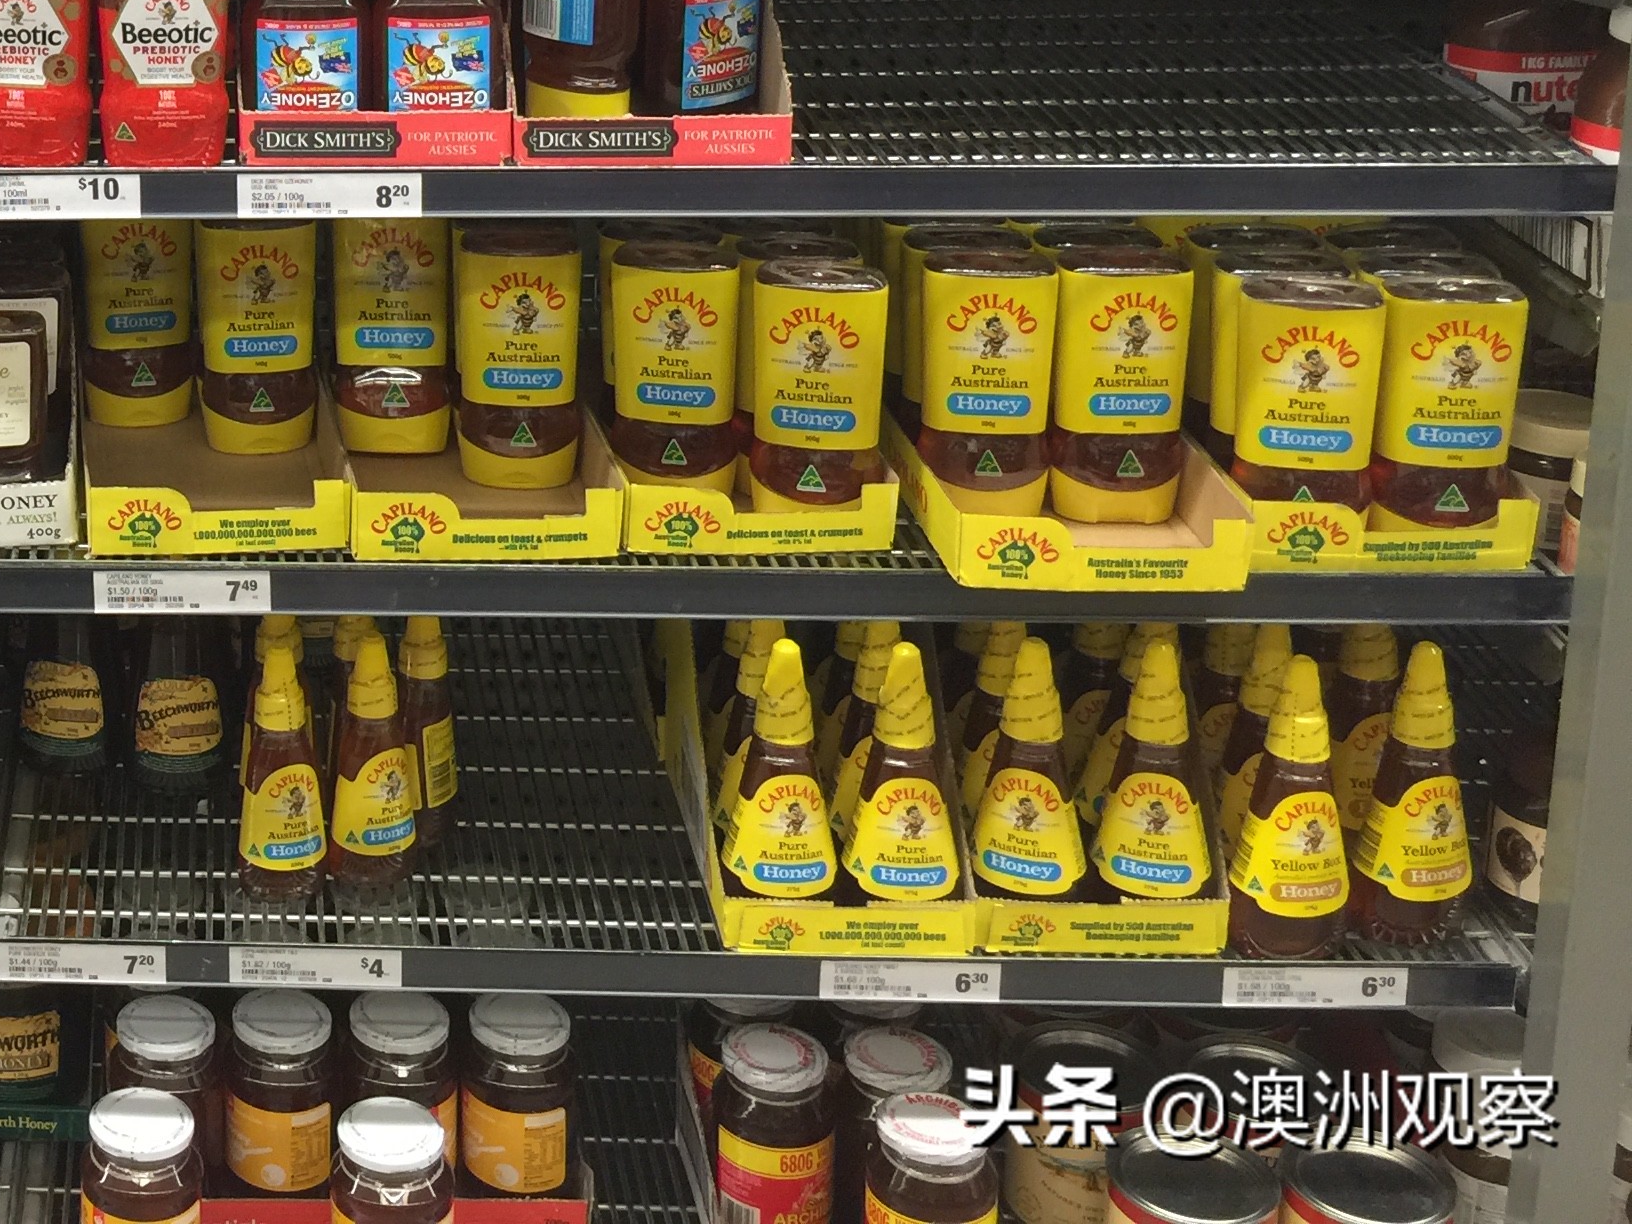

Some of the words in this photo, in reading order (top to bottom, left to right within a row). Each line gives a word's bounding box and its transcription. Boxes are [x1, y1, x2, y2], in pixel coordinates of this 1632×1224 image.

[122, 21, 213, 46] Beeotic
[133, 44, 200, 56] PREBIOTIC
[148, 55, 187, 65] HONEY
[390, 90, 489, 108] OZEHONEY
[265, 130, 307, 149] DICK
[314, 129, 385, 149] SMITH'S
[407, 132, 426, 144] FOR
[429, 131, 498, 144] PATRIOTIC
[540, 130, 582, 148] DICK
[588, 129, 661, 147] SMITH'S
[684, 130, 703, 141] FOR
[706, 129, 776, 141] PATRIOTIC
[428, 144, 477, 156] AUSSIES
[705, 142, 755, 154] AUSSIES
[78, 178, 120, 202] $10
[479, 273, 567, 312] CAPILANO
[947, 293, 1039, 335] CAPILANO
[504, 340, 537, 353] Pure
[486, 350, 562, 364] Australian
[491, 368, 555, 389] Honey
[1287, 398, 1326, 412] Pure
[1265, 411, 1350, 425] Australian
[1270, 429, 1344, 450] Honey
[7, 511, 58, 525] ALWAYS!
[27, 526, 61, 540] 400g
[1121, 781, 1190, 815] CAPILANO
[1271, 857, 1320, 873] Yellow
[1323, 855, 1342, 869] Box
[1279, 879, 1338, 900] Honey
[16, 1114, 58, 1133] Honey
[779, 1151, 815, 1174] 680G
